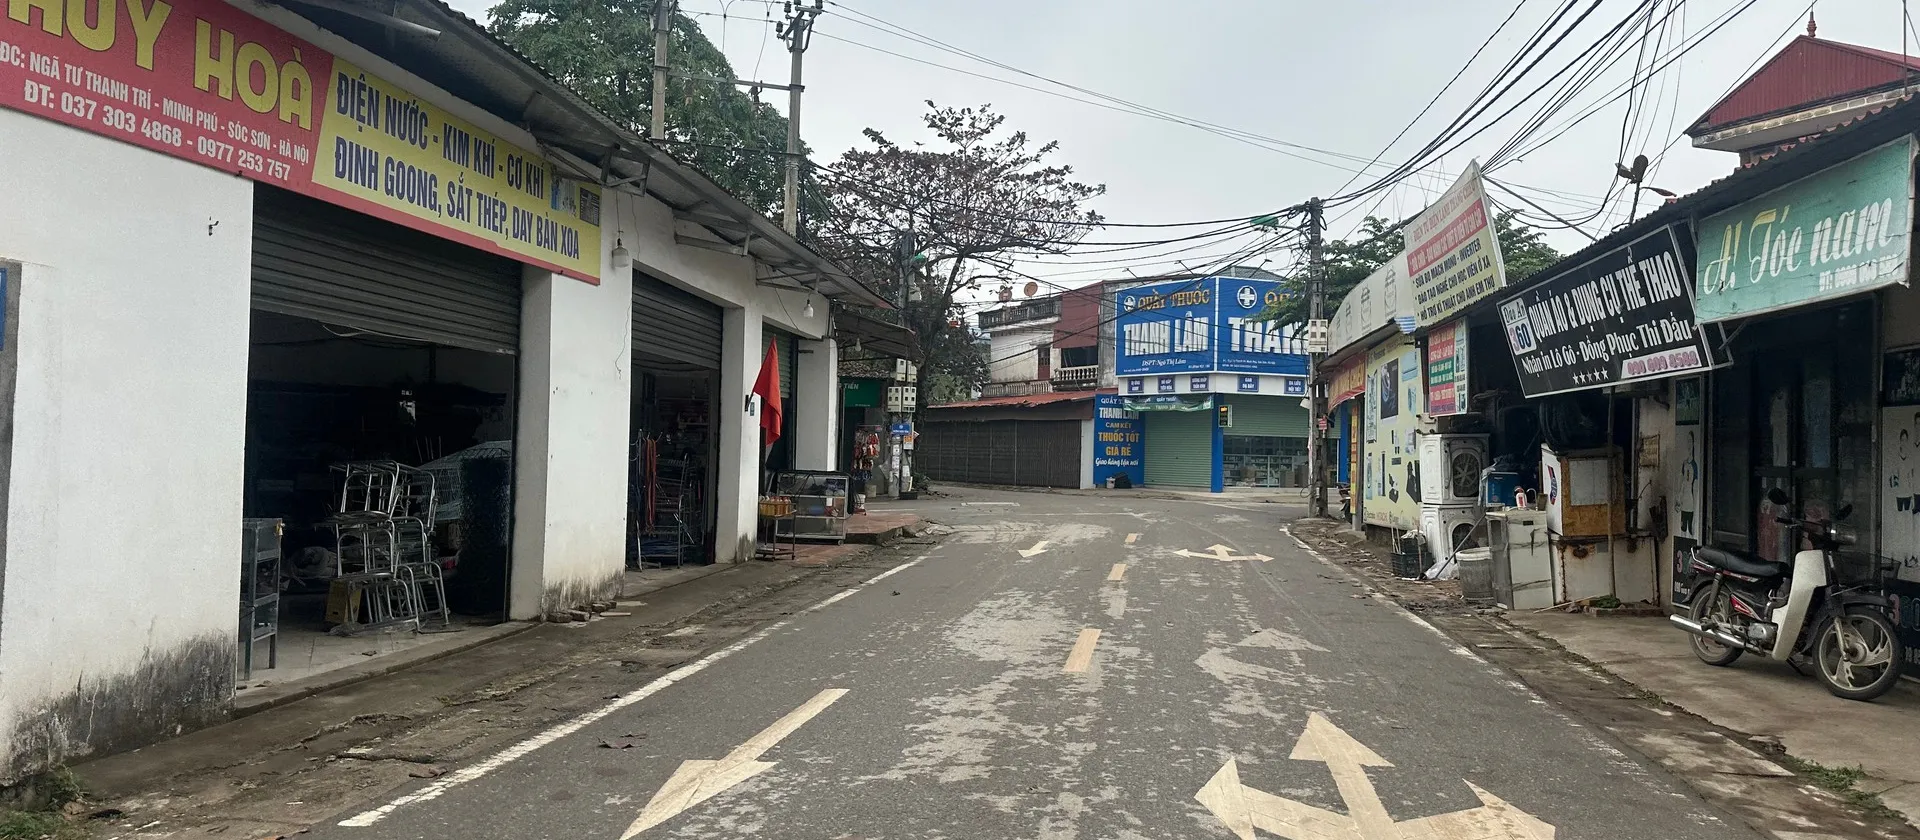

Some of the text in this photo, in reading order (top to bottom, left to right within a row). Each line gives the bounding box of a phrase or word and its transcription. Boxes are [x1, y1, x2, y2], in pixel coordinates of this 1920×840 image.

[29, 51, 60, 81] NGÃ
[64, 63, 83, 86] TƯ
[85, 70, 128, 103] THANH
[131, 87, 152, 110] TRÍ
[162, 97, 194, 125] MINH
[196, 110, 218, 133] PHÚ
[228, 120, 248, 142] SÓC
[250, 127, 271, 151] SƠN
[279, 138, 291, 158] HÀ
[293, 144, 310, 166] NỘI
[193, 17, 313, 131] HOÀ
[24, 80, 55, 108] ĐT:
[61, 92, 98, 121] 037
[102, 105, 136, 133] 303
[140, 117, 182, 147] 4868
[197, 136, 233, 163] 0977
[237, 151, 264, 173] 253
[267, 158, 291, 181] 757
[336, 72, 379, 132] ĐIỆN
[385, 94, 429, 150] NƯỚC
[442, 123, 470, 166] KIM
[474, 138, 495, 179] KHÍ
[507, 153, 523, 189] CƠ
[526, 162, 544, 199] KHÍ
[335, 137, 579, 259] ĐINH GOONG, SẮT THÉP, DAY BÀN XOA
[1810, 197, 1894, 267] nam
[1170, 283, 1210, 307] THUỐC
[1528, 291, 1554, 341] QUẦN
[1574, 280, 1607, 331] DỤNG
[1640, 251, 1681, 304] THAO
[1124, 311, 1210, 356] THANH LÂM
[1508, 323, 1532, 352] 360
[1521, 353, 1543, 377] Nhận
[1542, 350, 1550, 370] in
[1550, 346, 1563, 368] Lô
[1562, 345, 1576, 366] Gô
[1579, 335, 1609, 362] Đồng
[1606, 331, 1639, 358] Phục
[1636, 319, 1661, 347] Thi
[1660, 312, 1693, 344] Đấu
[1098, 429, 1140, 443] THUỐC TỐT
[1099, 407, 1122, 419] THANH
